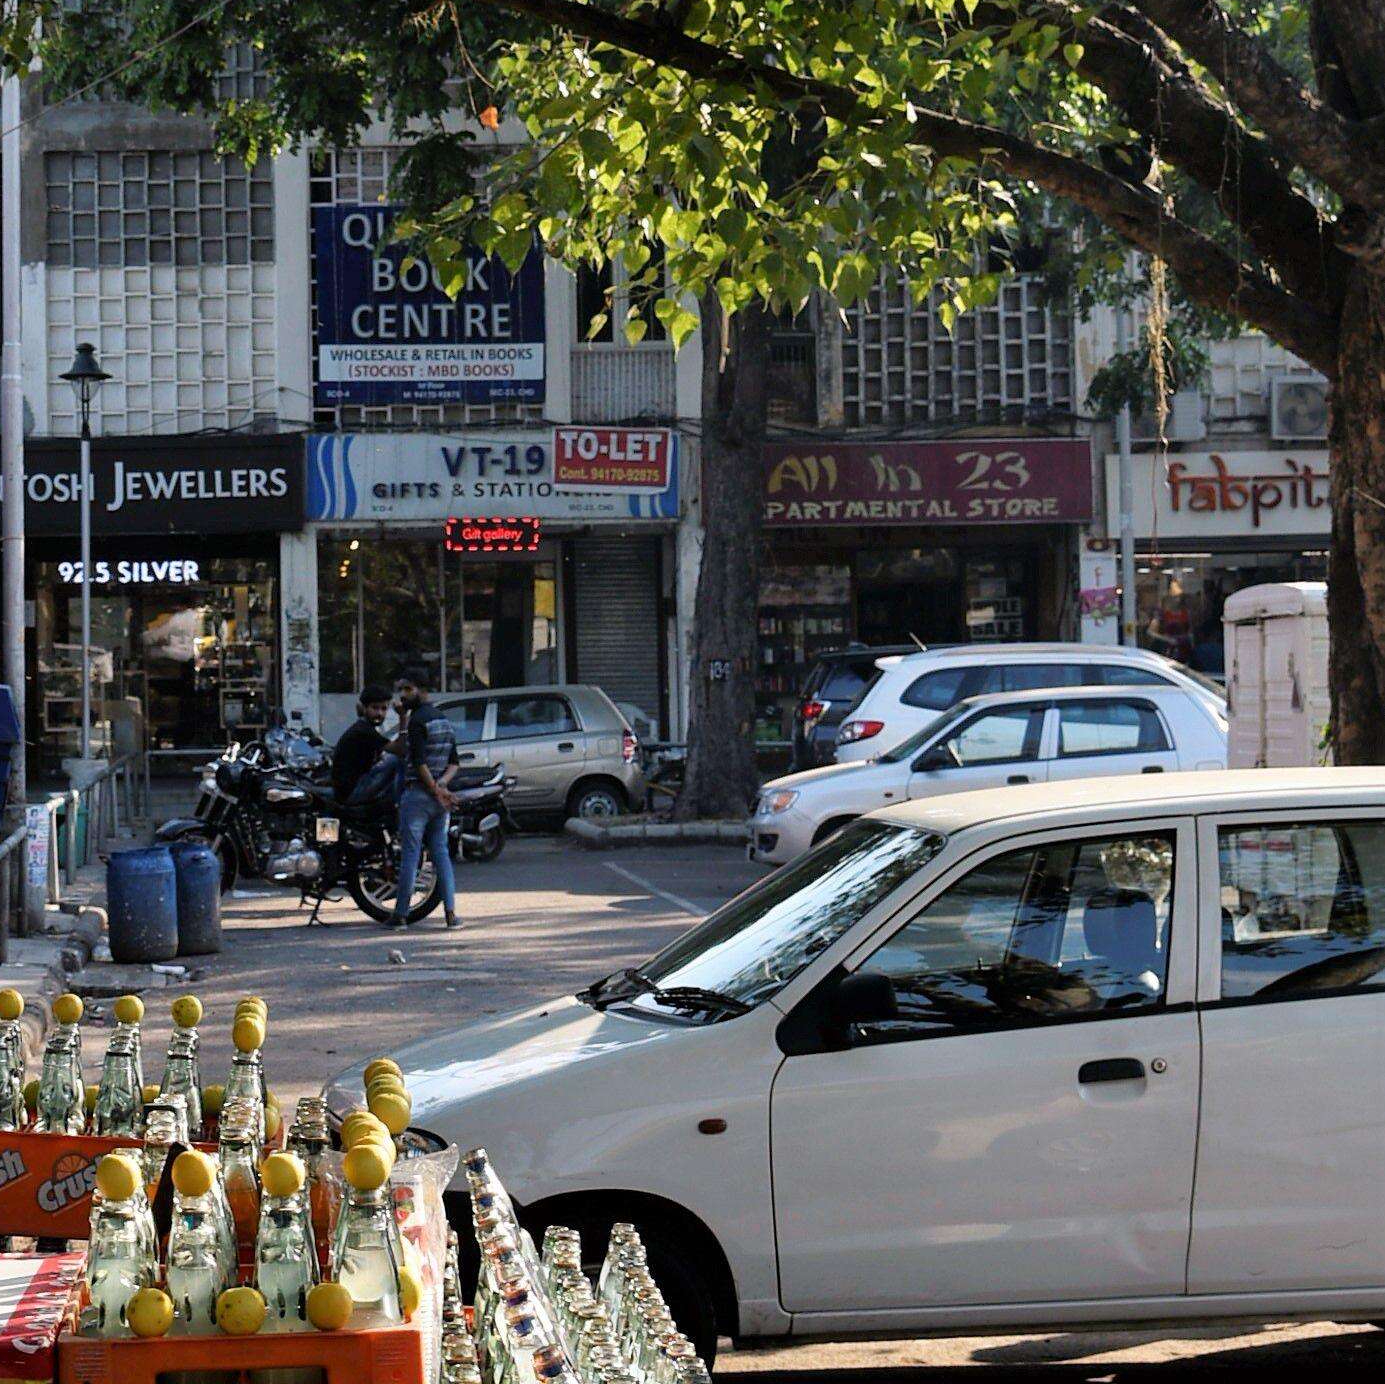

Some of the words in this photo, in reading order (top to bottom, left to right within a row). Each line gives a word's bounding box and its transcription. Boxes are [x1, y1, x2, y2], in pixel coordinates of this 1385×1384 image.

[351, 303, 512, 339] CENTRE
[330, 350, 408, 361] WHOLESALE
[412, 350, 421, 361] &
[425, 350, 466, 361] RETAIL
[470, 349, 484, 360] IN
[488, 348, 533, 360] BOOKS
[348, 365, 415, 377] (STOCKIST
[427, 365, 460, 376] MBD
[464, 364, 515, 377] BOOKS)
[441, 445, 545, 477] VT-19
[560, 431, 663, 462] TO-LET
[106, 462, 288, 512] JEWELLERS
[767, 455, 837, 492] All
[955, 451, 1029, 490] 23
[372, 482, 441, 499] GIFTS
[452, 482, 465, 497] &
[474, 481, 613, 498] STATIO
[1167, 454, 1330, 528] fabpit
[764, 498, 958, 520] PARTMENTAL
[966, 497, 1058, 517] STORE
[117, 560, 200, 584] SILVER
[37, 1153, 102, 1213] Crus
